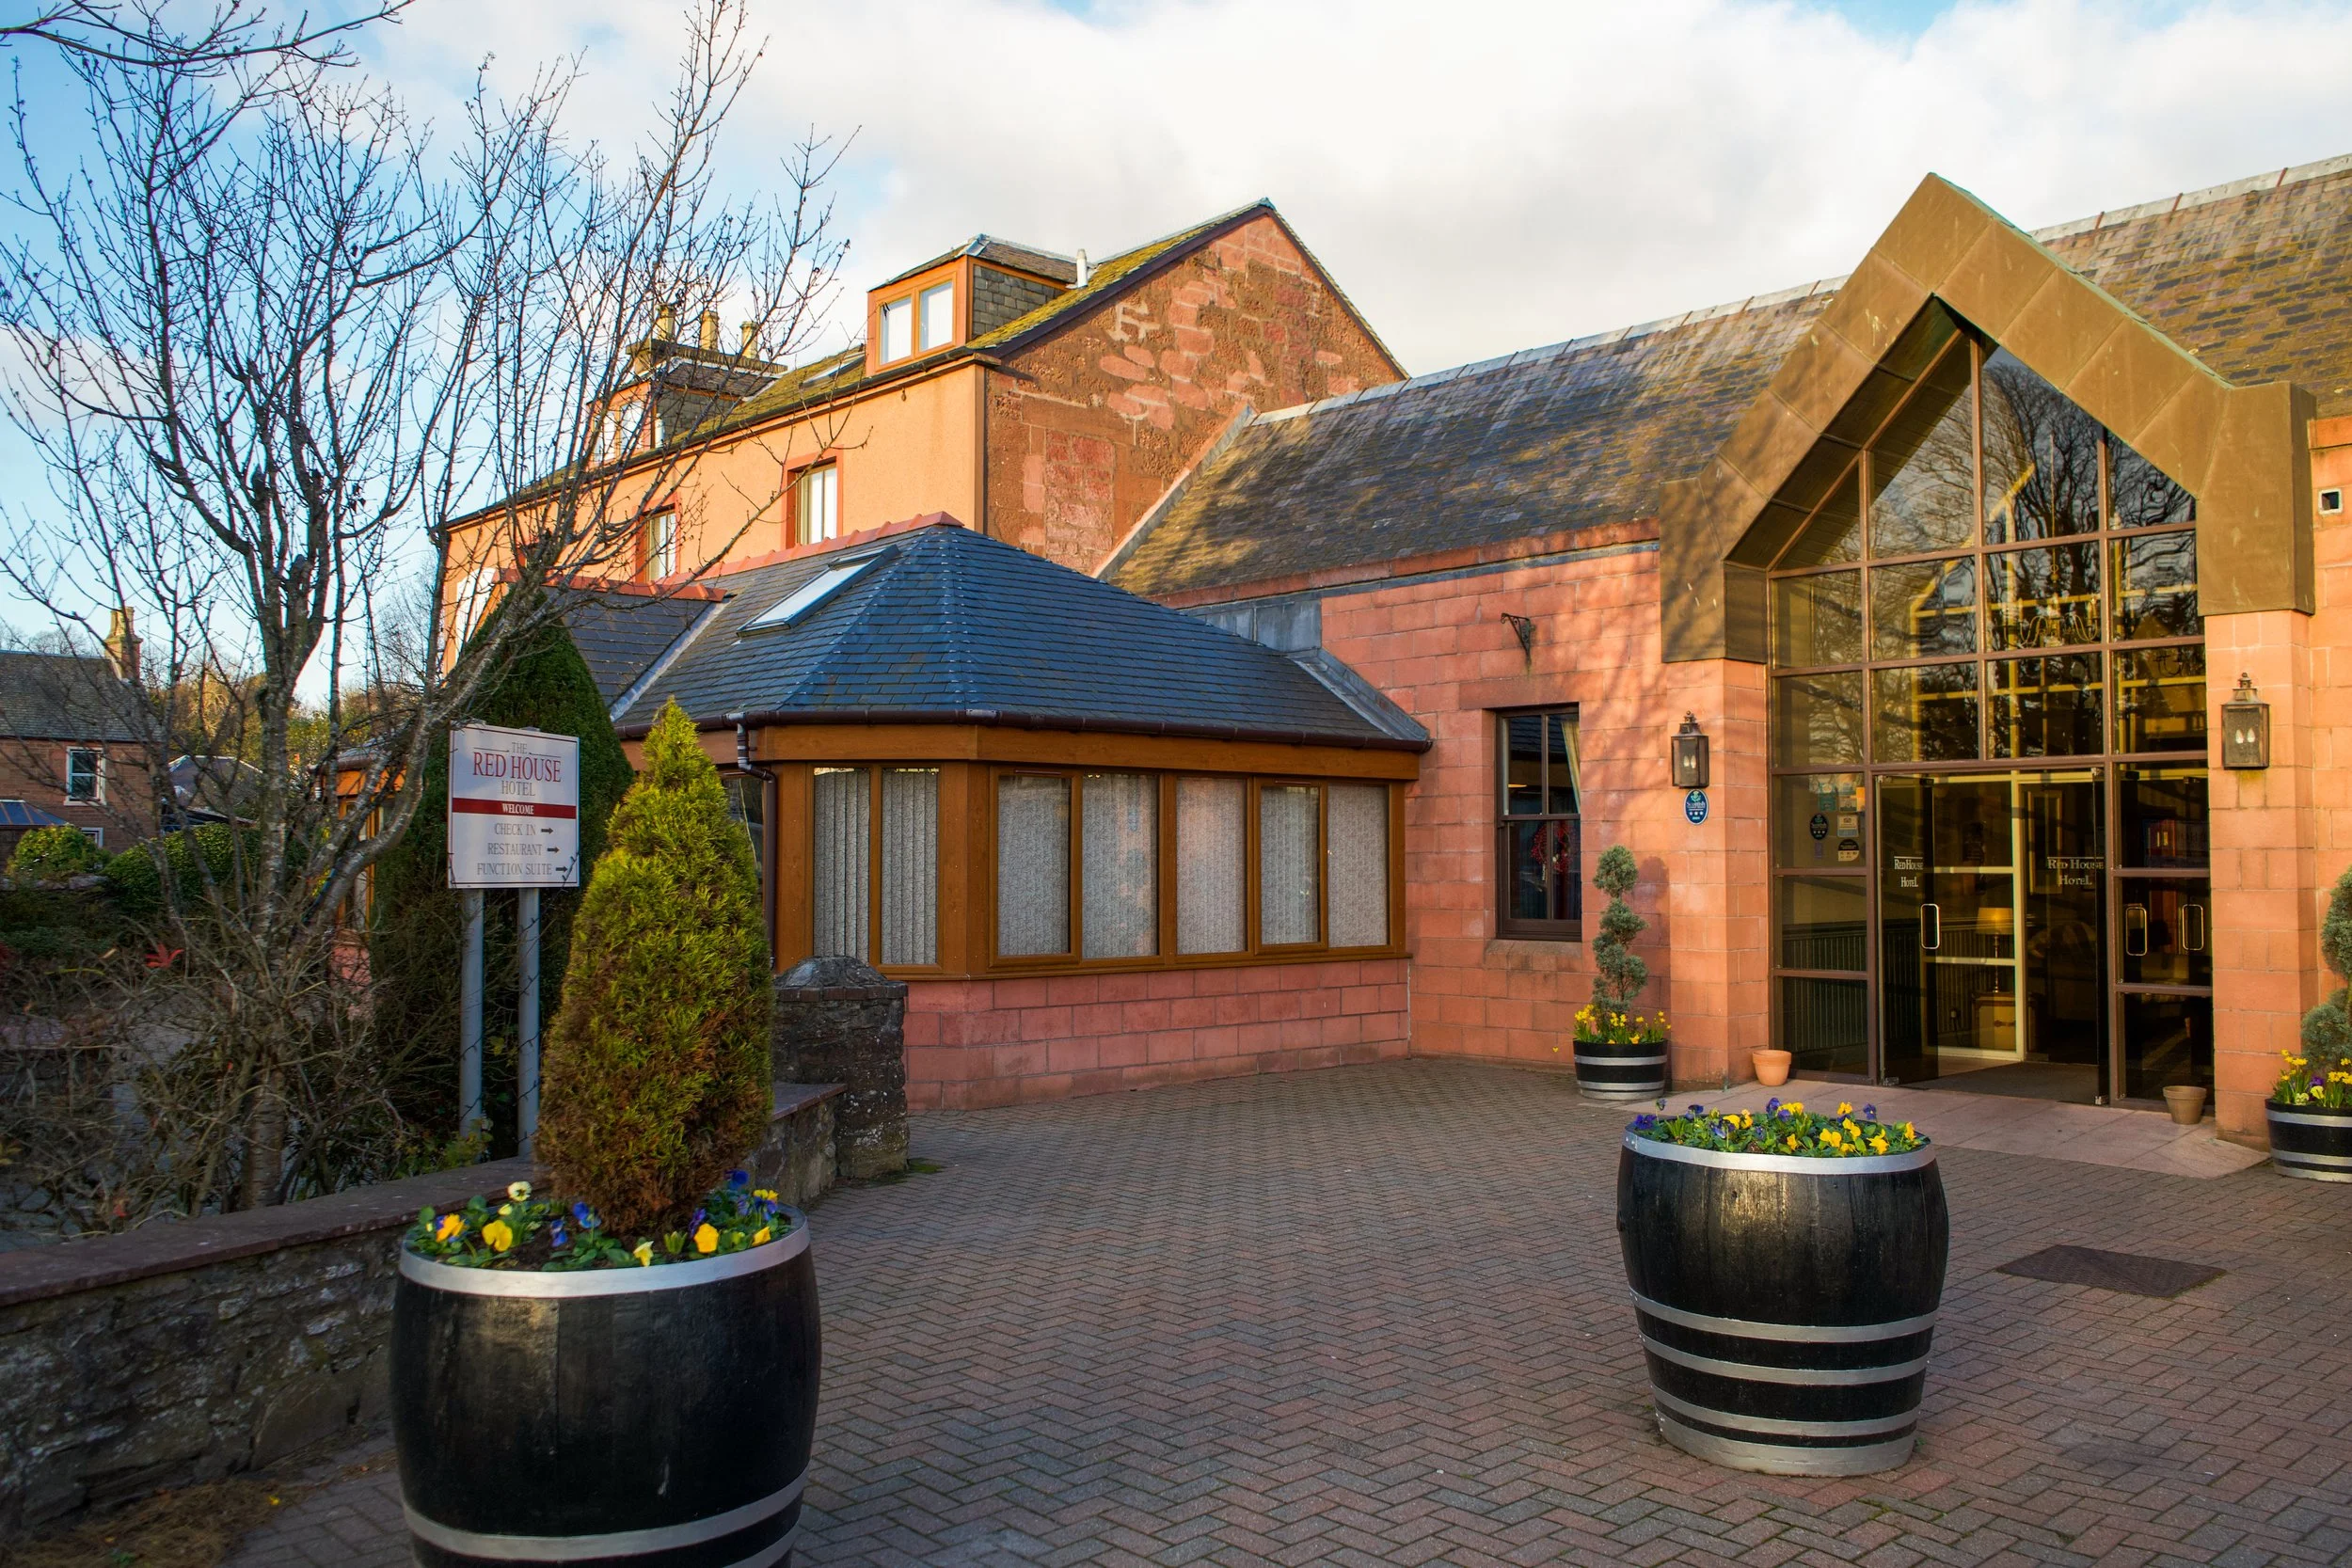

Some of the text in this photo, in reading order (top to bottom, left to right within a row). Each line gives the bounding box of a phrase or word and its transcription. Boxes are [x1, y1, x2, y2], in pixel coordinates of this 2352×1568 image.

[511, 742, 527, 754] THE
[473, 752, 562, 783] RED HOUSE
[501, 780, 535, 797] HOTEL
[501, 803, 534, 815] WELCOME
[494, 822, 536, 836] CHECK IN
[487, 843, 543, 856] RESTAURANT
[477, 863, 552, 876] FUNCTION SUITE
